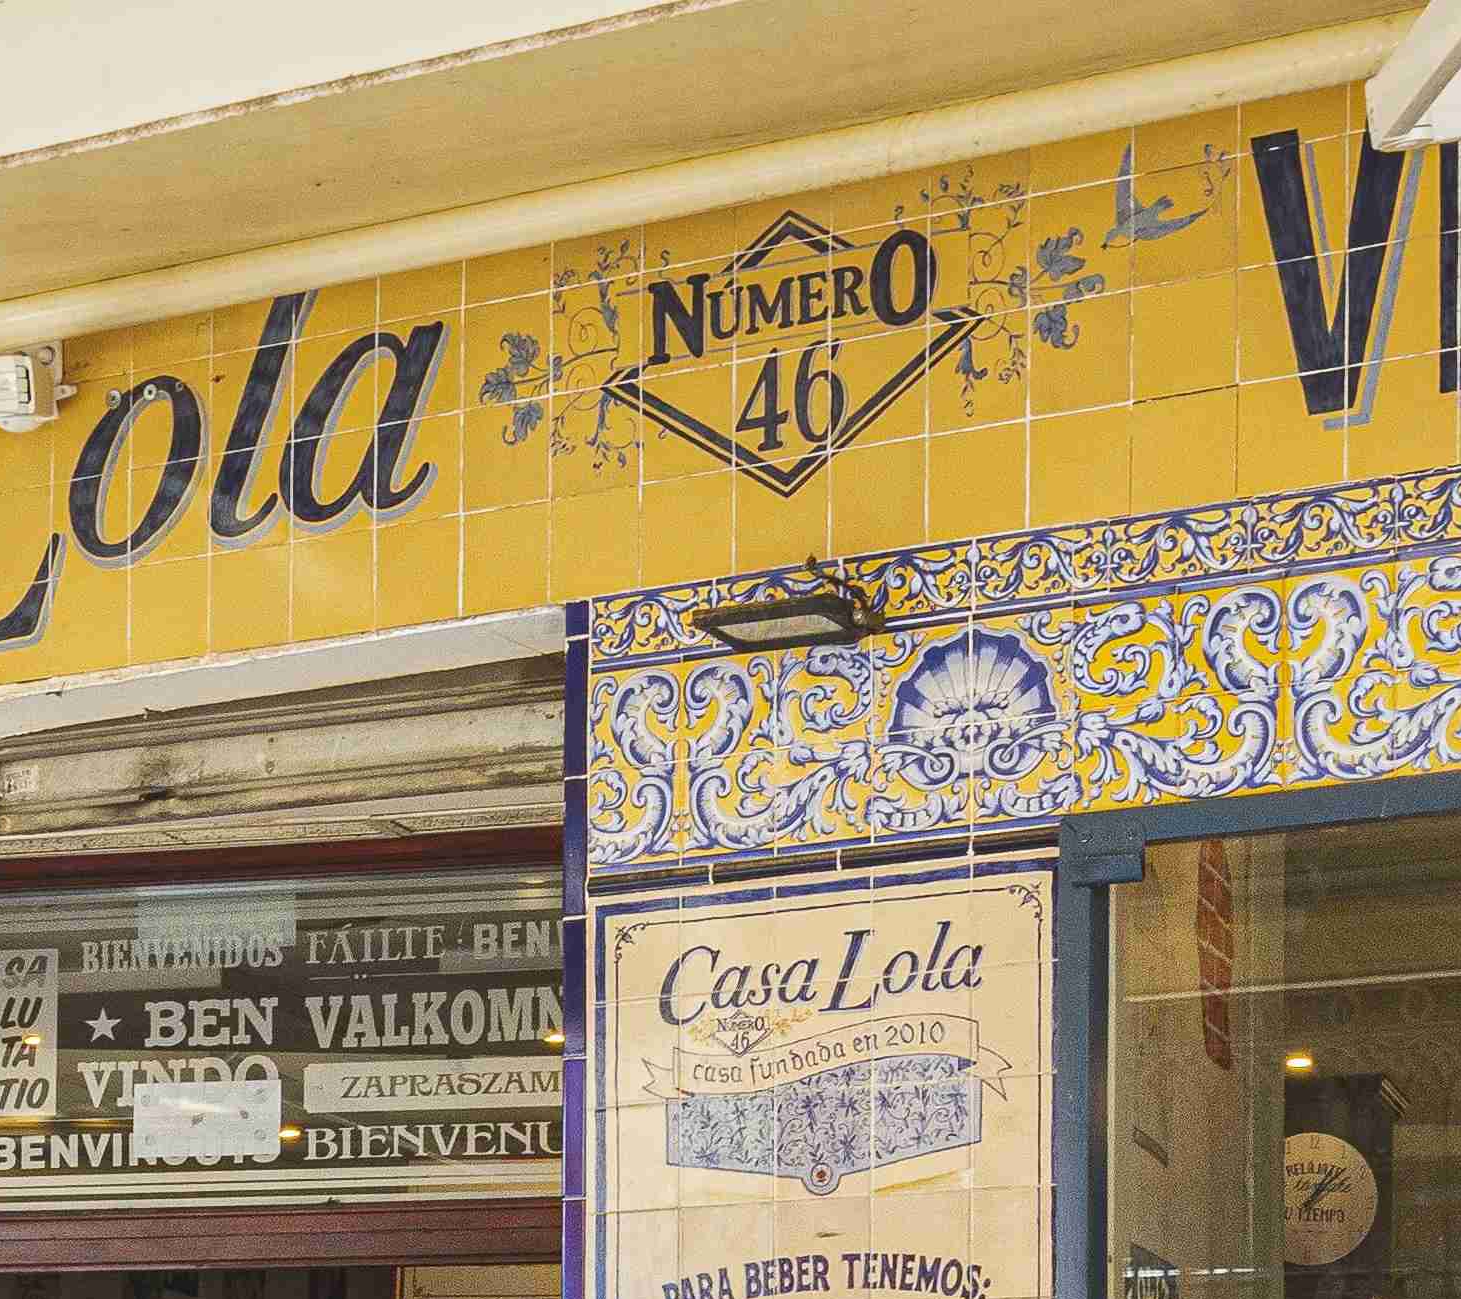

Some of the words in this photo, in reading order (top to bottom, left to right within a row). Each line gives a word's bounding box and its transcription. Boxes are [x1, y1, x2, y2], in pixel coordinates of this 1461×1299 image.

[648, 229, 939, 365] NÚMERO
[735, 340, 848, 452] 46
[4, 955, 48, 990] SA
[80, 933, 283, 976] BIENVENIDOS
[659, 944, 817, 1026] Casa
[819, 920, 984, 1014] Lola
[0, 995, 44, 1030] LU
[144, 996, 279, 1049] BEN
[692, 1064, 743, 1085] casa
[750, 1043, 846, 1086] fundada
[853, 1031, 880, 1054] en
[884, 1020, 946, 1047] 2010
[745, 1259, 831, 1299] BEBER
